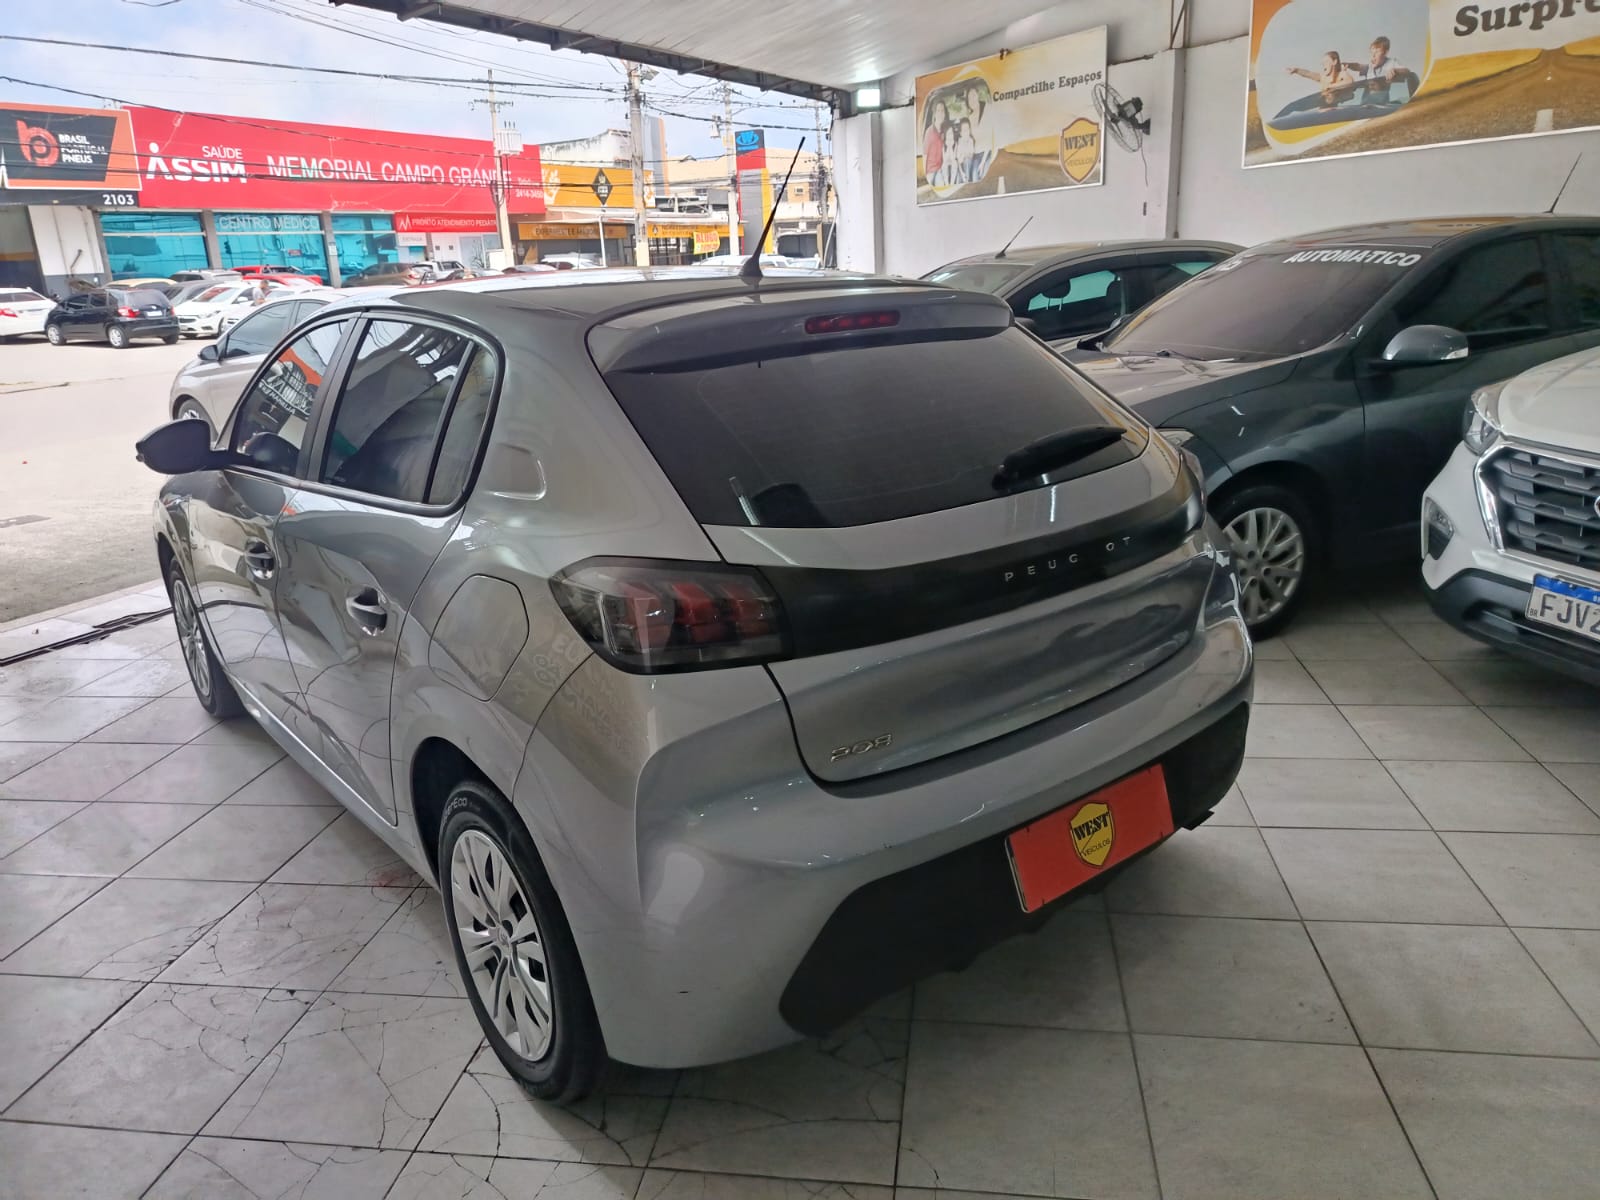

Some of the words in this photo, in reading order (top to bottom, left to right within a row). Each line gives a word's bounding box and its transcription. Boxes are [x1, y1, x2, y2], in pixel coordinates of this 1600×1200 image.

[992, 80, 1055, 102] Compartilhe
[1058, 70, 1102, 88] Espaços
[58, 133, 90, 145] BRASIL
[1064, 132, 1098, 150] WEST
[61, 153, 94, 164] PNEUS
[201, 144, 243, 160] SAÚDE
[266, 155, 378, 182] MEMORIAL
[381, 162, 446, 184] CAMPO
[102, 194, 135, 205] 2103
[219, 216, 272, 230] CENTRO
[1073, 811, 1110, 841] WEST
